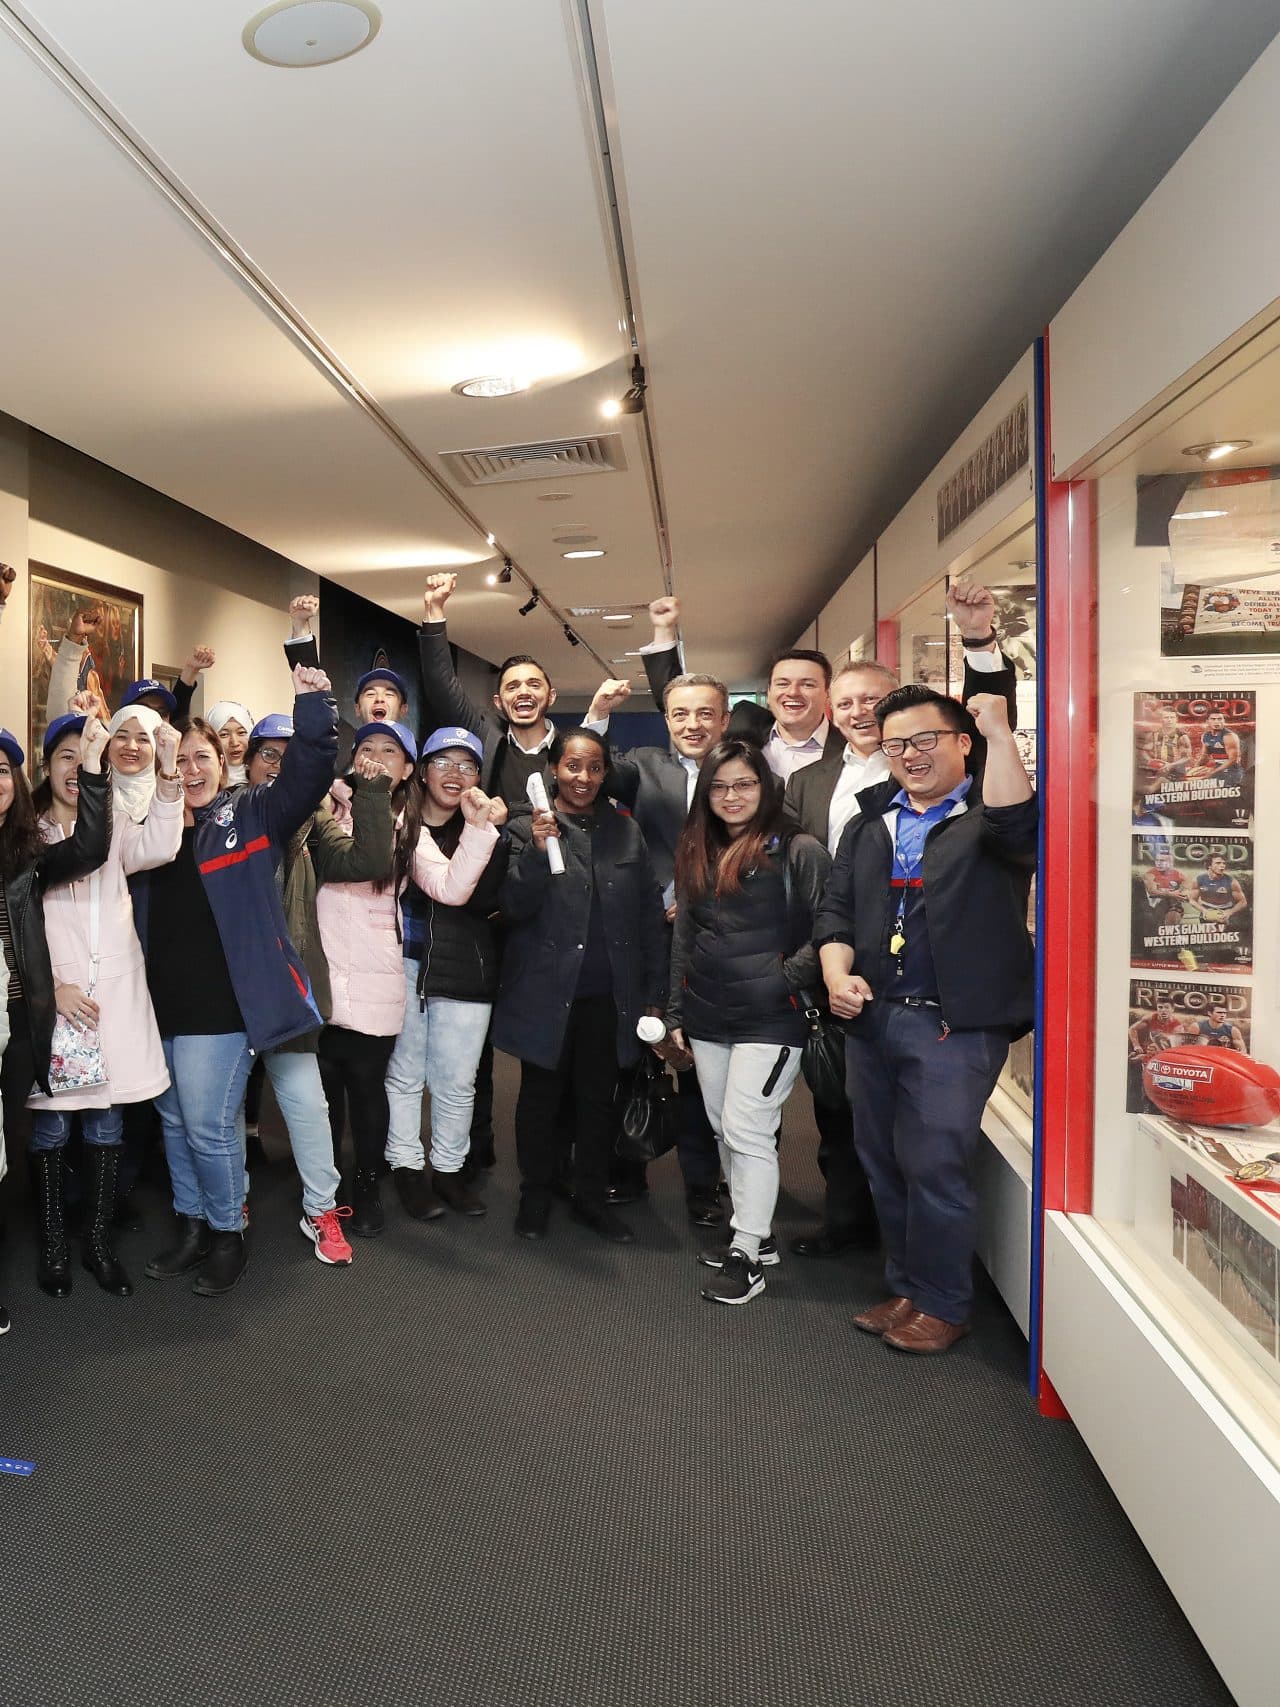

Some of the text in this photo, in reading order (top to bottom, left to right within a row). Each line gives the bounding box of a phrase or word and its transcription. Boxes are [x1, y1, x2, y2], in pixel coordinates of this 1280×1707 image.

[1160, 778, 1217, 793] HAWTHORN
[1145, 786, 1241, 805] WESTERN BULLDOGS
[1158, 924, 1181, 936] GWS
[1181, 922, 1217, 935] GIANTS
[1143, 931, 1241, 947] WESTERN BULLDOGS
[1172, 1067, 1208, 1079] TOYOTA
